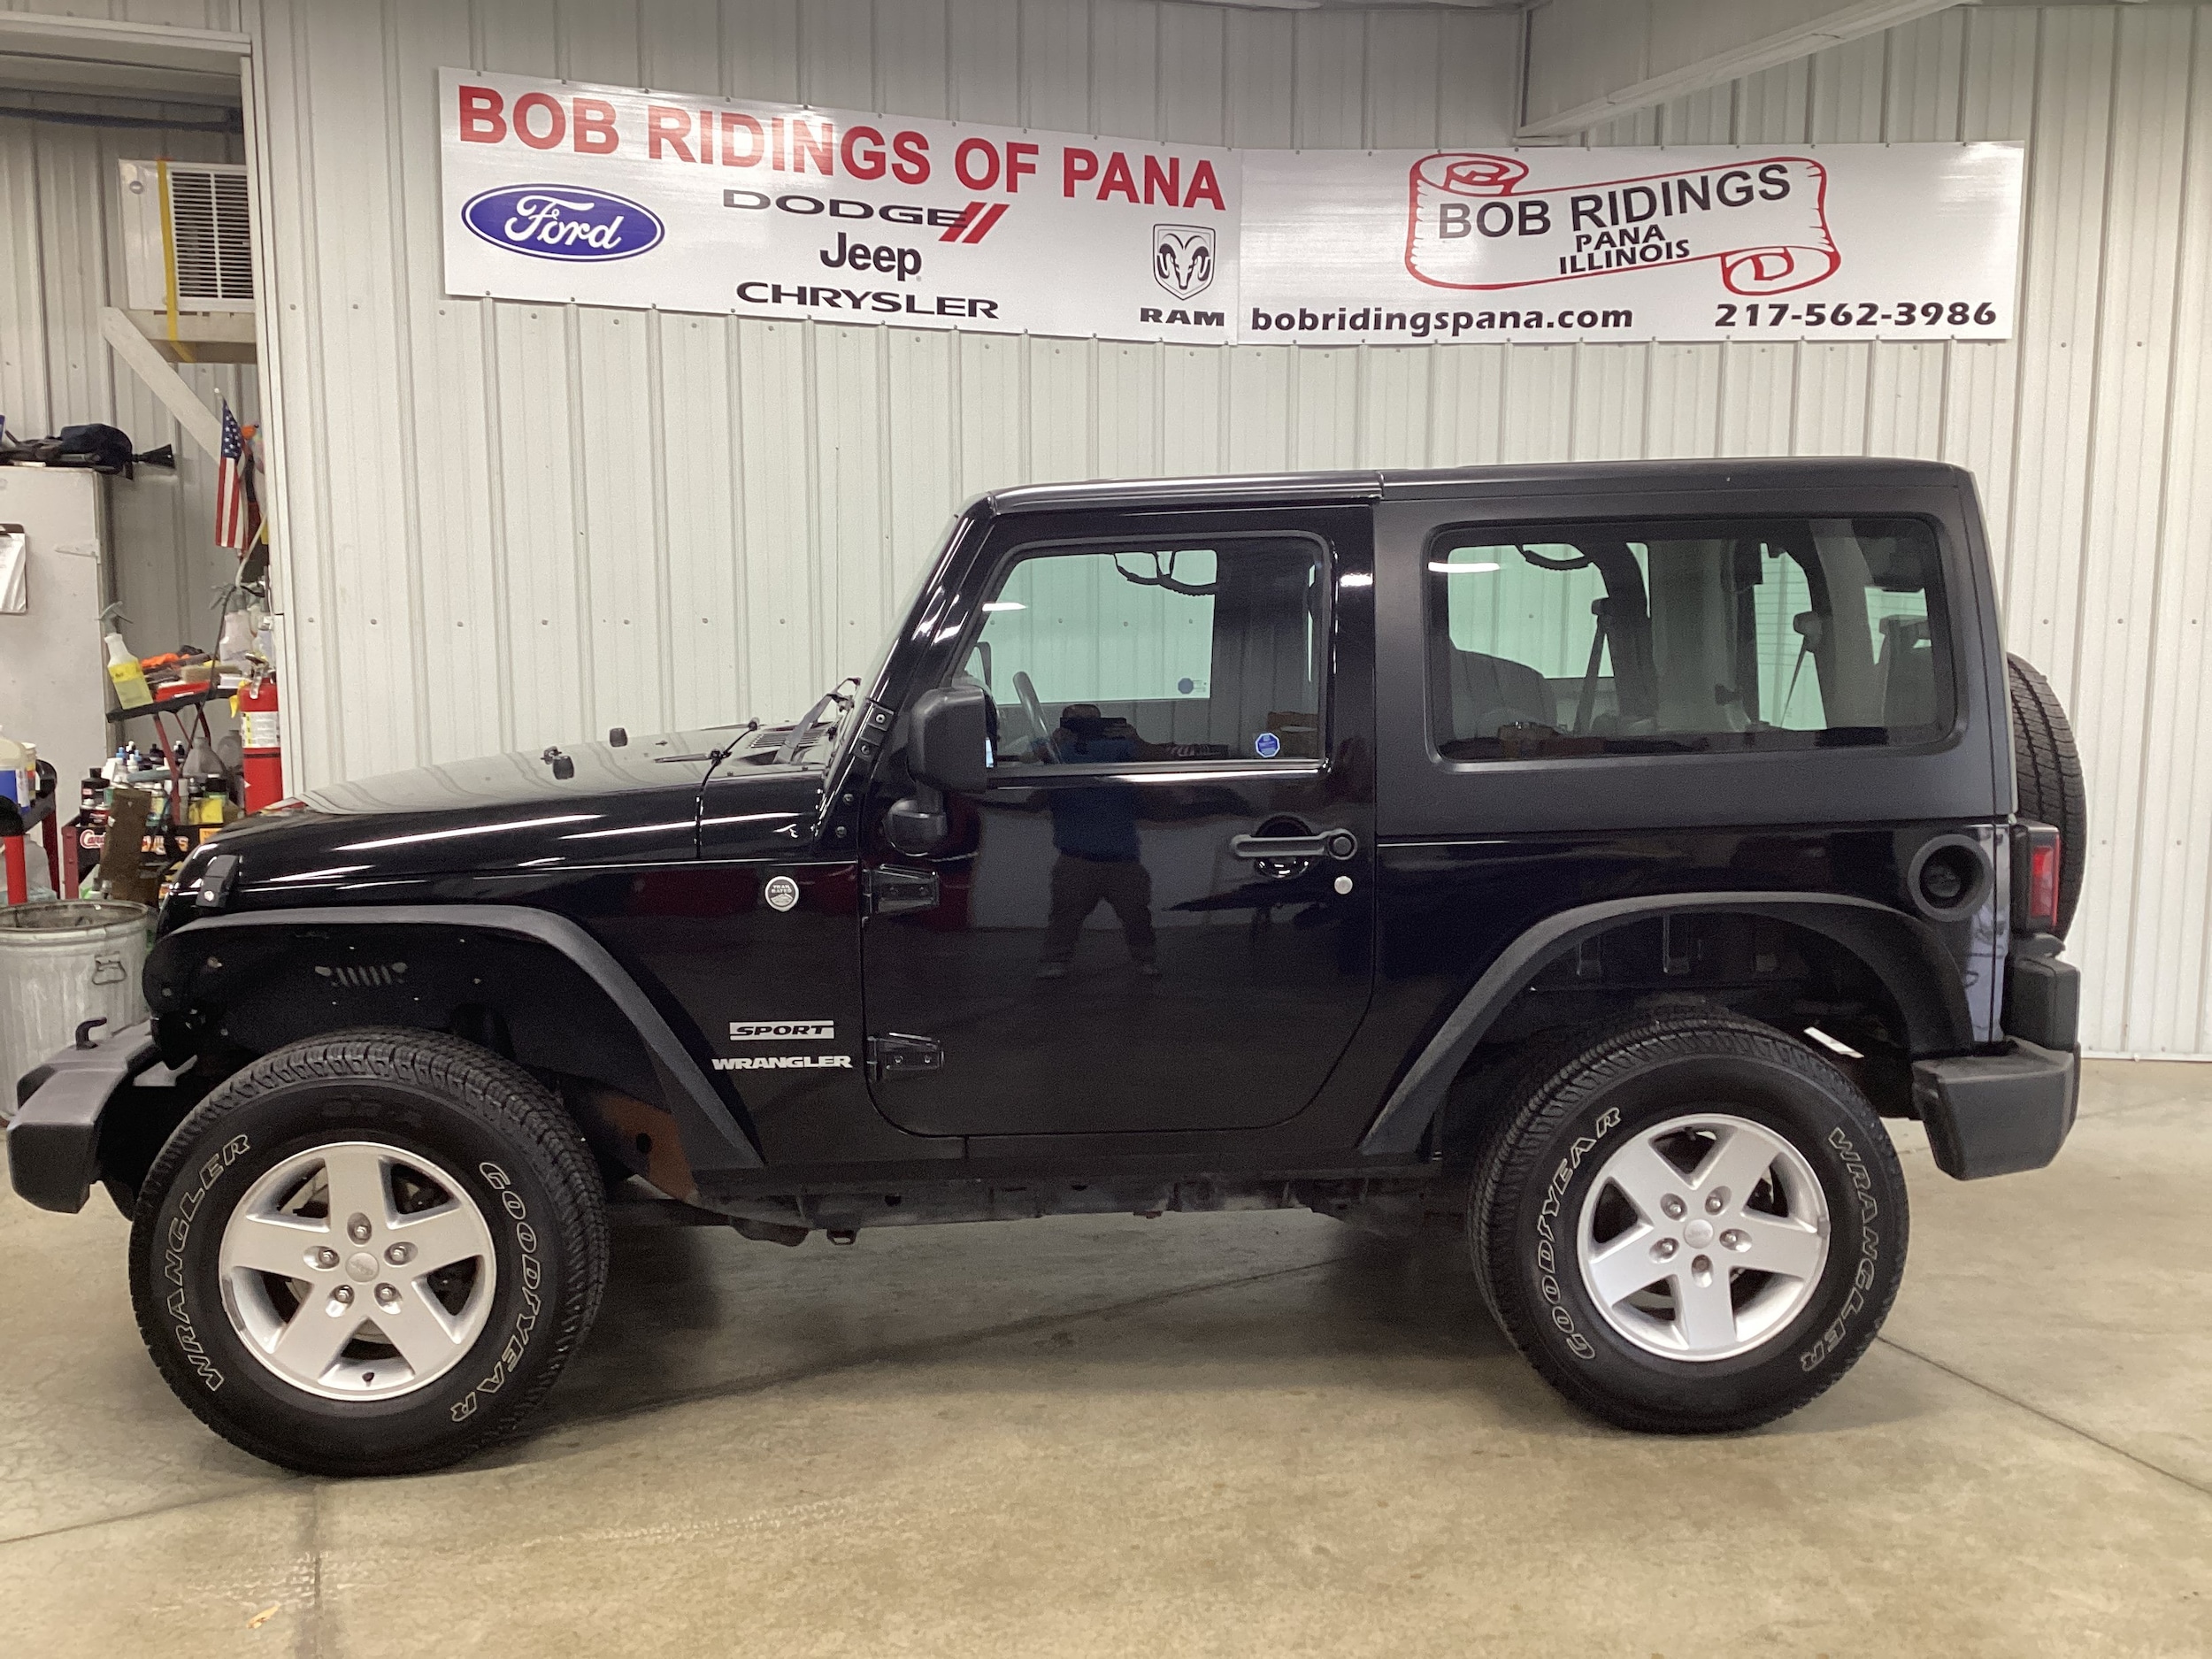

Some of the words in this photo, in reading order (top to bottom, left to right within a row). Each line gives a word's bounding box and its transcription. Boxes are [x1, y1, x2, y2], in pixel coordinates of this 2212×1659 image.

[458, 84, 619, 155] BOB
[649, 106, 931, 187] RIDINGS
[954, 137, 1040, 194] OF
[1063, 147, 1226, 211] PANA
[723, 188, 969, 228] DODGE
[1439, 193, 1552, 239] BOB
[1571, 164, 1791, 232] RIDINGS
[503, 195, 625, 250] Ford
[1576, 225, 1666, 253] PANA
[820, 232, 922, 282] Jeep
[1559, 239, 1691, 275] ILLINOIS
[736, 281, 999, 319] CHRYSLER
[1140, 307, 1225, 326] RAM
[1715, 301, 1997, 328] 217-562-3986
[1251, 306, 1633, 338] bobridingspana.com
[736, 1025, 828, 1036] SPORT
[711, 1056, 853, 1070] WRANGLER
[1537, 1107, 1622, 1360] GOODYEAR
[1801, 1126, 1879, 1372] WRANGLER
[165, 1133, 251, 1392] WRANGLER
[449, 1161, 542, 1423] GOODYEAR
